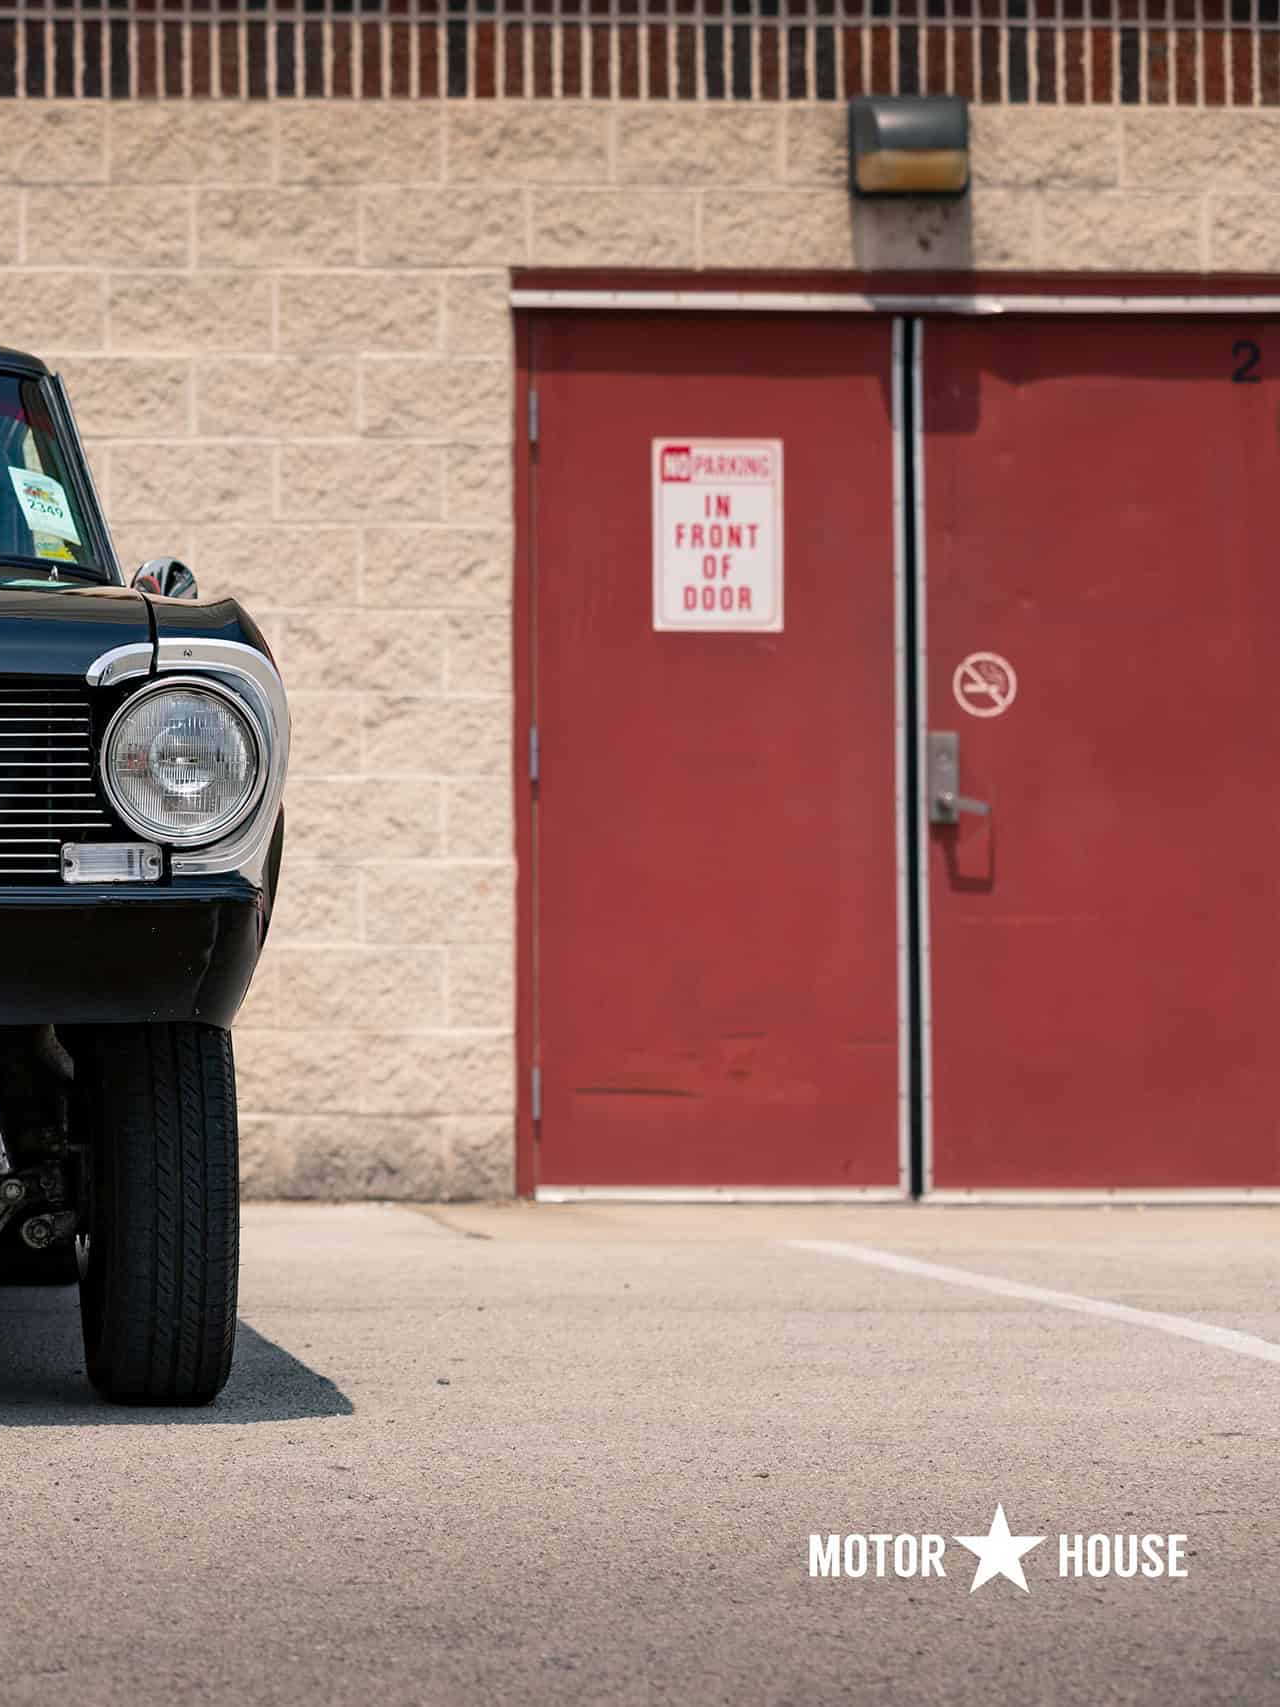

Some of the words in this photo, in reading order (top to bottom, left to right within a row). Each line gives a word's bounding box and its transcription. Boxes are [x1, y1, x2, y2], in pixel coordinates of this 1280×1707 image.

[1231, 339, 1262, 384] 2
[664, 453, 691, 478] NO
[693, 454, 770, 478] PARKING
[705, 494, 731, 518] IN
[675, 523, 758, 549] FRONT
[703, 554, 731, 580] OF
[683, 585, 753, 612] DOOR
